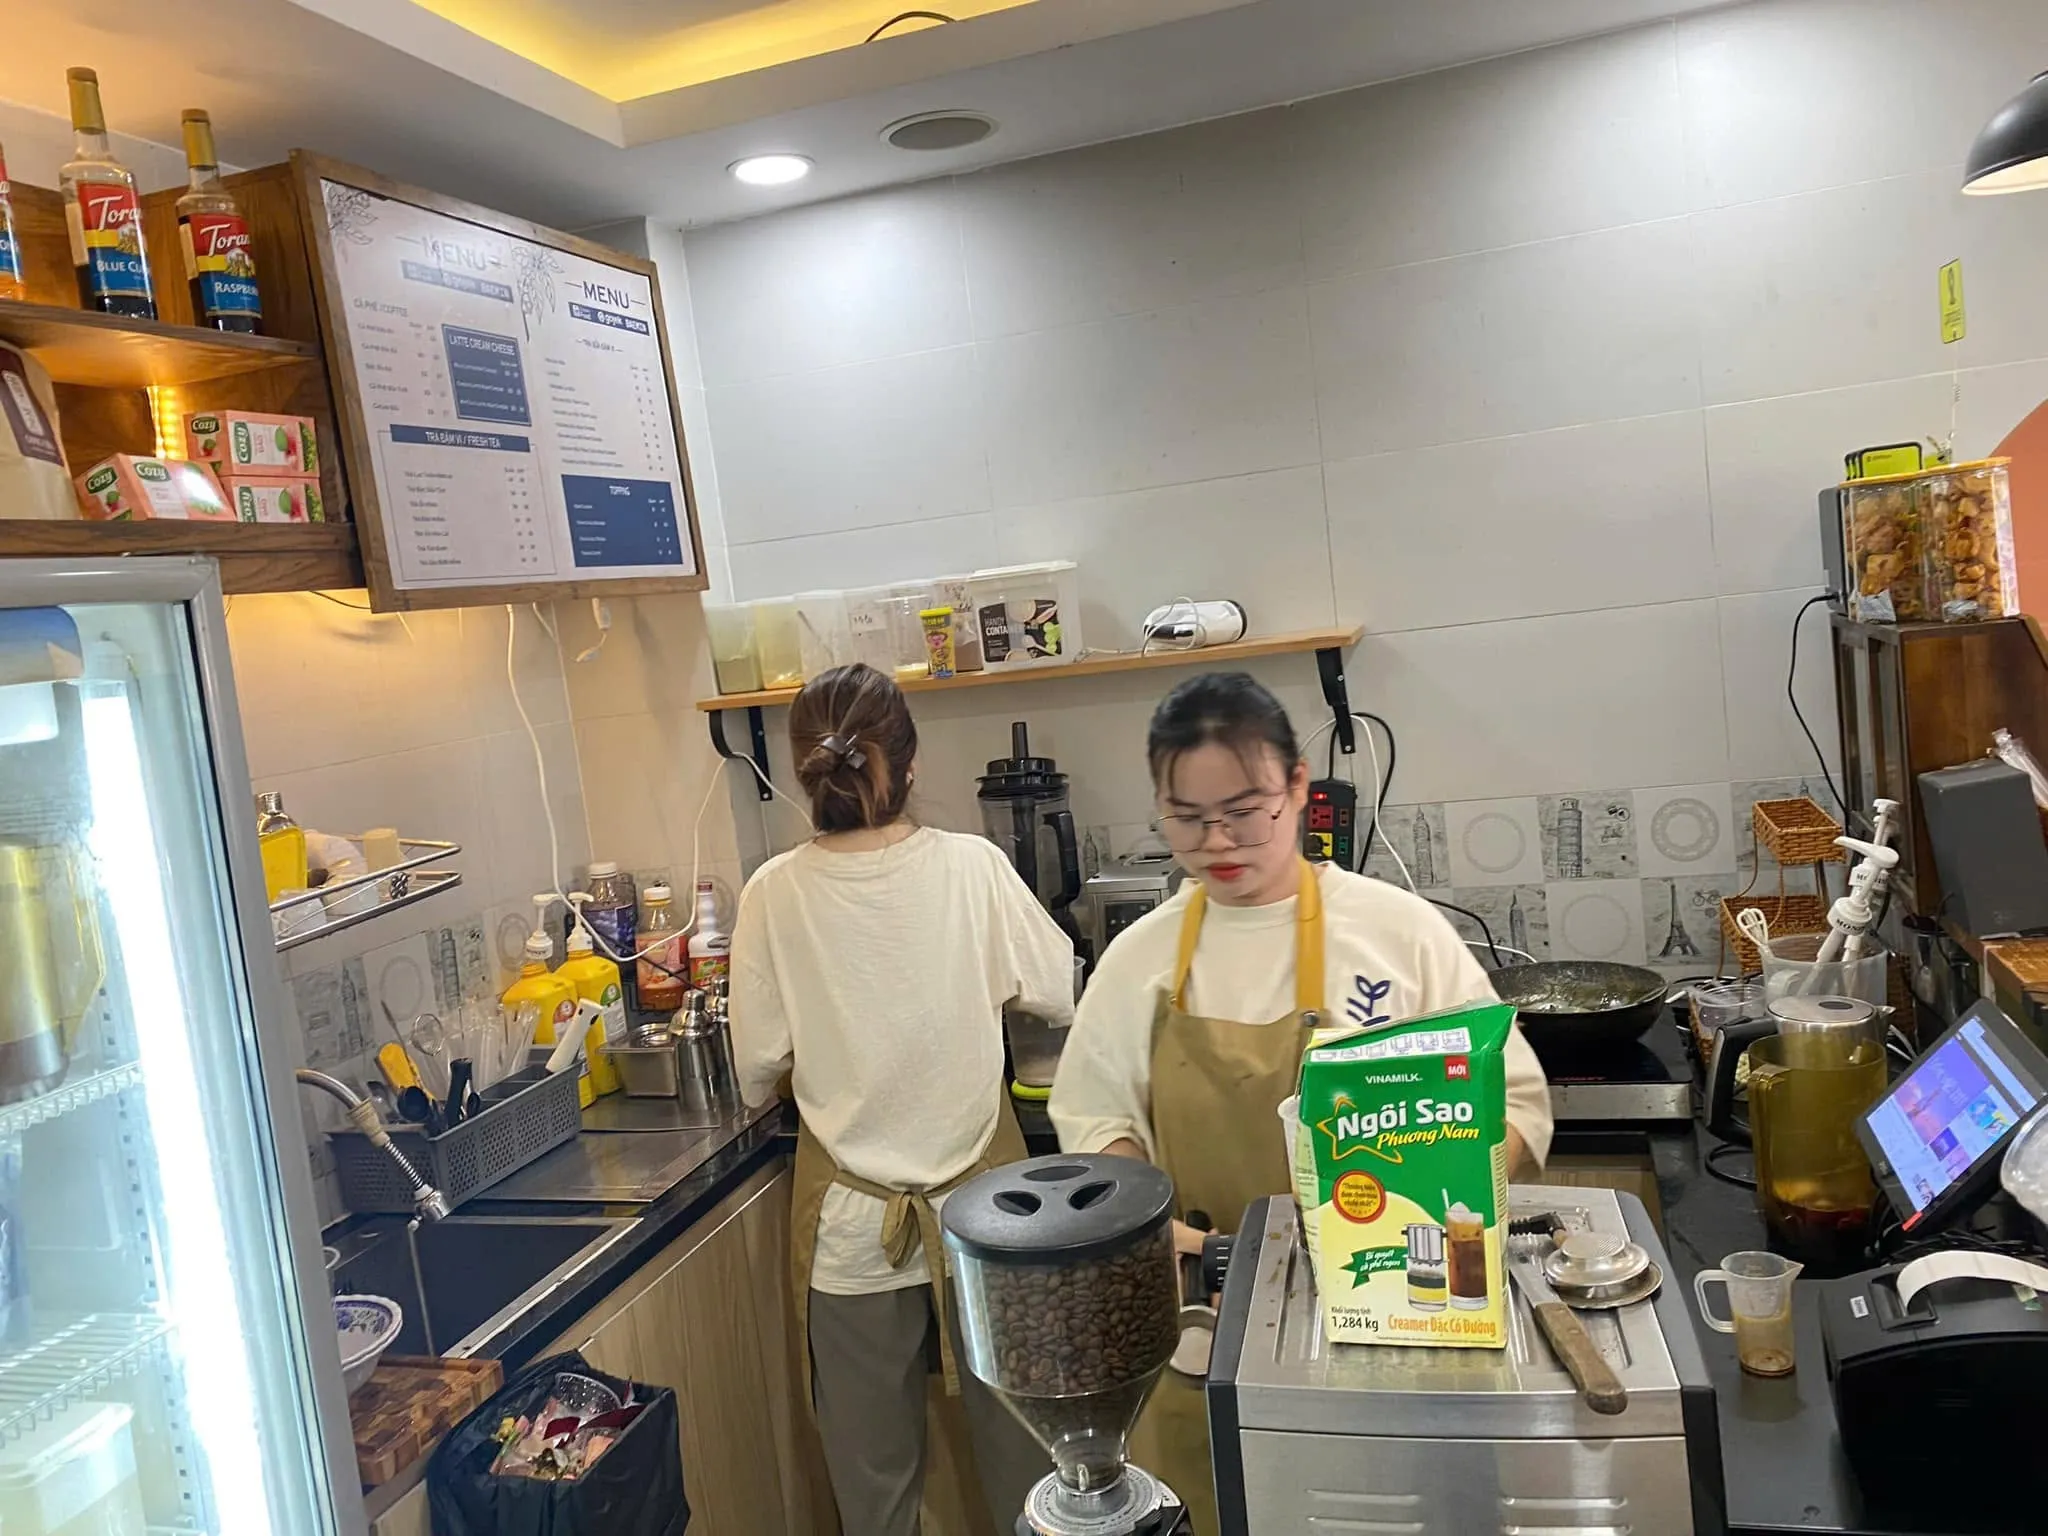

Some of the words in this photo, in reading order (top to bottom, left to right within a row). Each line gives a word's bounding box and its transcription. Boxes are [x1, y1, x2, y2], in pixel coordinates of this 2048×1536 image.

[422, 236, 487, 271] MENU
[96, 260, 127, 272] BLUE
[583, 281, 630, 309] MENU
[449, 334, 469, 348] LATTE
[491, 341, 515, 356] CHEESE
[192, 419, 217, 432] Cozy
[237, 426, 249, 461] Cozy
[467, 435, 488, 447] FRESH
[488, 437, 501, 449] TEA
[87, 472, 113, 490] Cozy
[136, 464, 166, 480] Cozy
[1447, 1063, 1467, 1076] MỚI
[1337, 1100, 1407, 1141] Ngôi
[1415, 1098, 1473, 1124] Sao
[1376, 1127, 1438, 1150] Phương
[1438, 1122, 1480, 1140] Nam
[1332, 1316, 1362, 1329] 1,284
[1365, 1316, 1379, 1332] kg
[1388, 1314, 1429, 1332] Creamer
[1430, 1316, 1449, 1335] Đặc
[1450, 1315, 1463, 1334] Có
[1463, 1317, 1496, 1338] Đường
